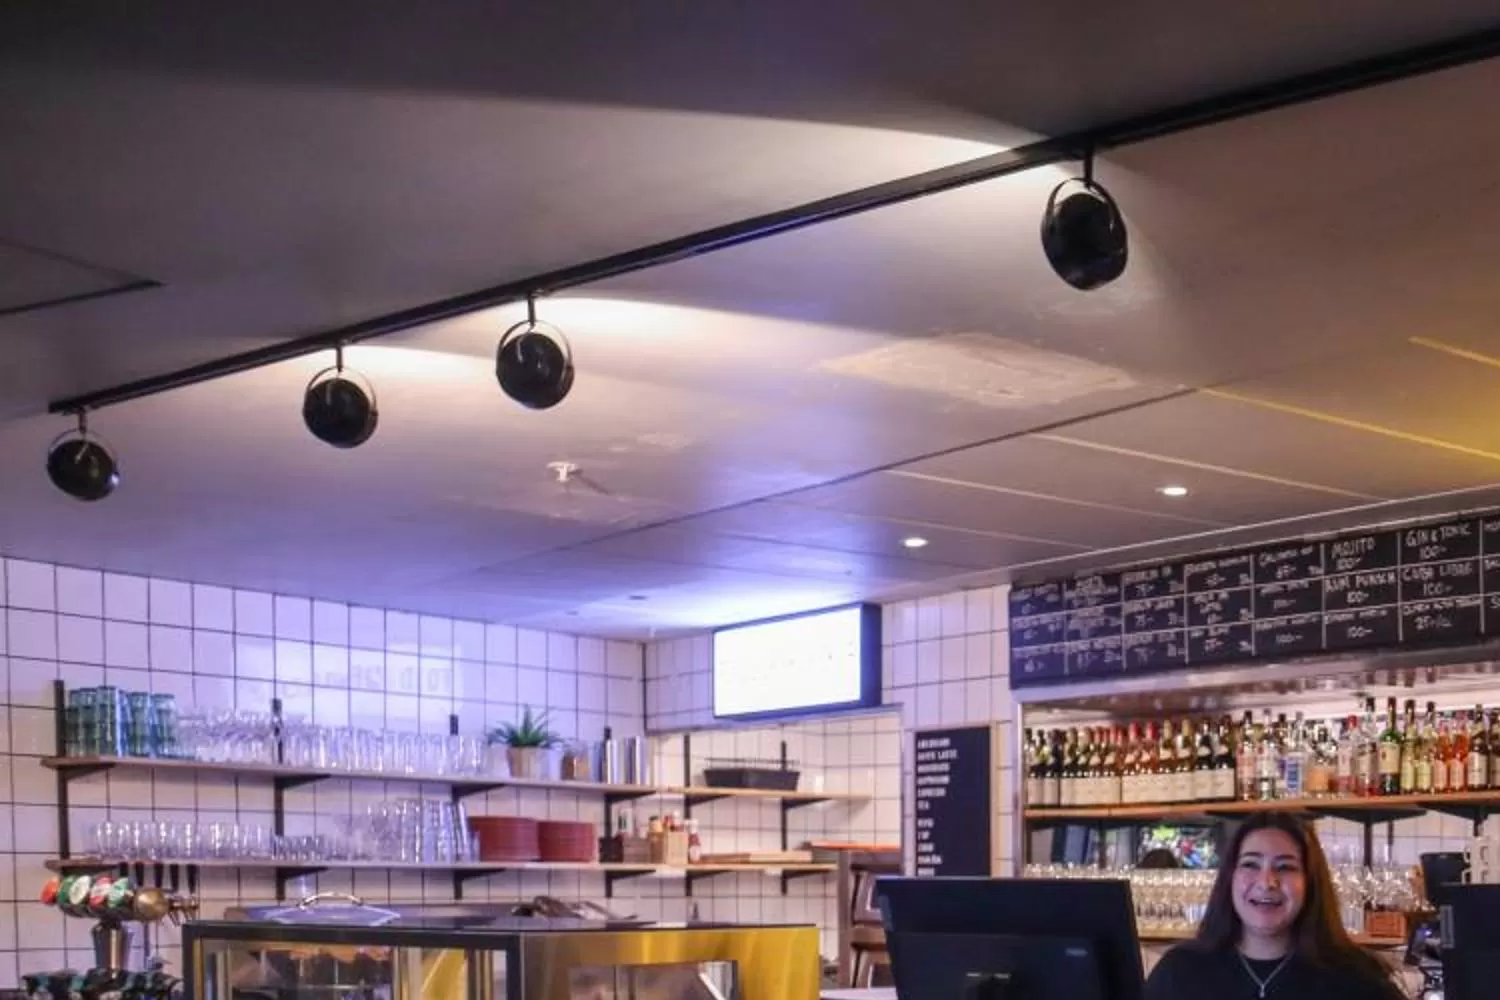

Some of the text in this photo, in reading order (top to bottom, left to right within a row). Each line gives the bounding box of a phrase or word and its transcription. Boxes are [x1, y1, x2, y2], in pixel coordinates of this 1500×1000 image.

[1405, 529, 1428, 547] GIN
[1440, 523, 1472, 540] TONIC
[1331, 537, 1376, 559] MOJITO
